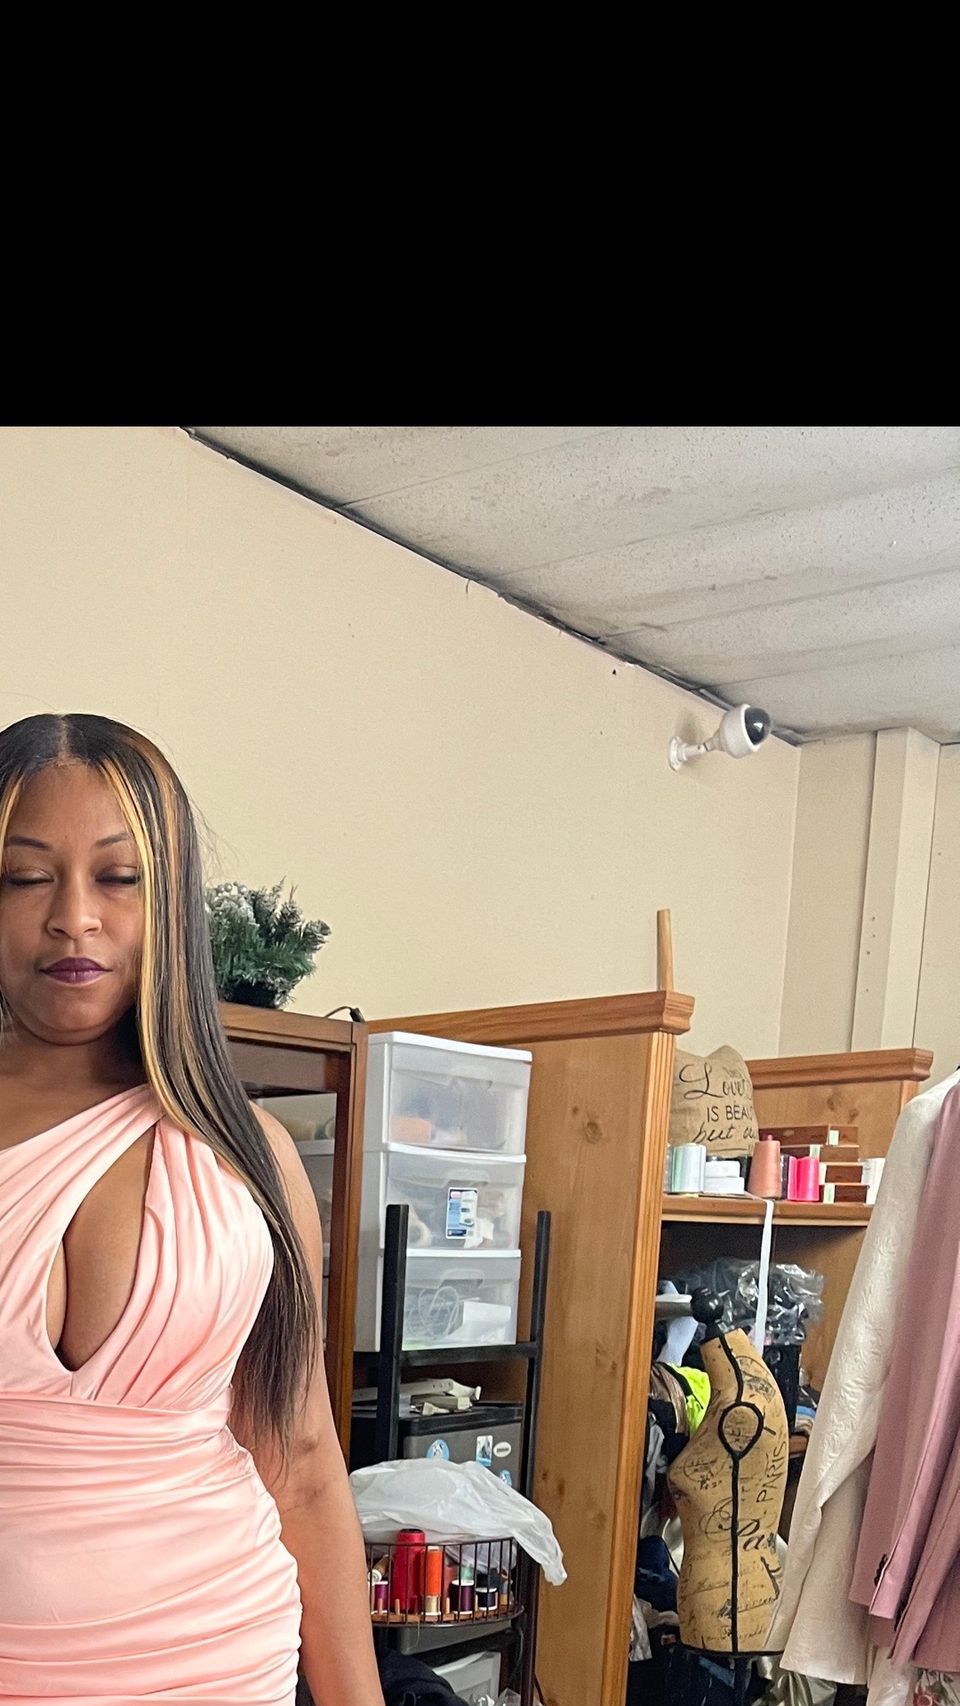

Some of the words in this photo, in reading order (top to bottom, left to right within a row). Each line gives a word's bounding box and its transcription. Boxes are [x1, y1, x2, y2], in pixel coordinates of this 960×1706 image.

[707, 1105, 720, 1122] IS
[691, 1121, 736, 1144] but
[757, 1440, 786, 1503] PARIS
